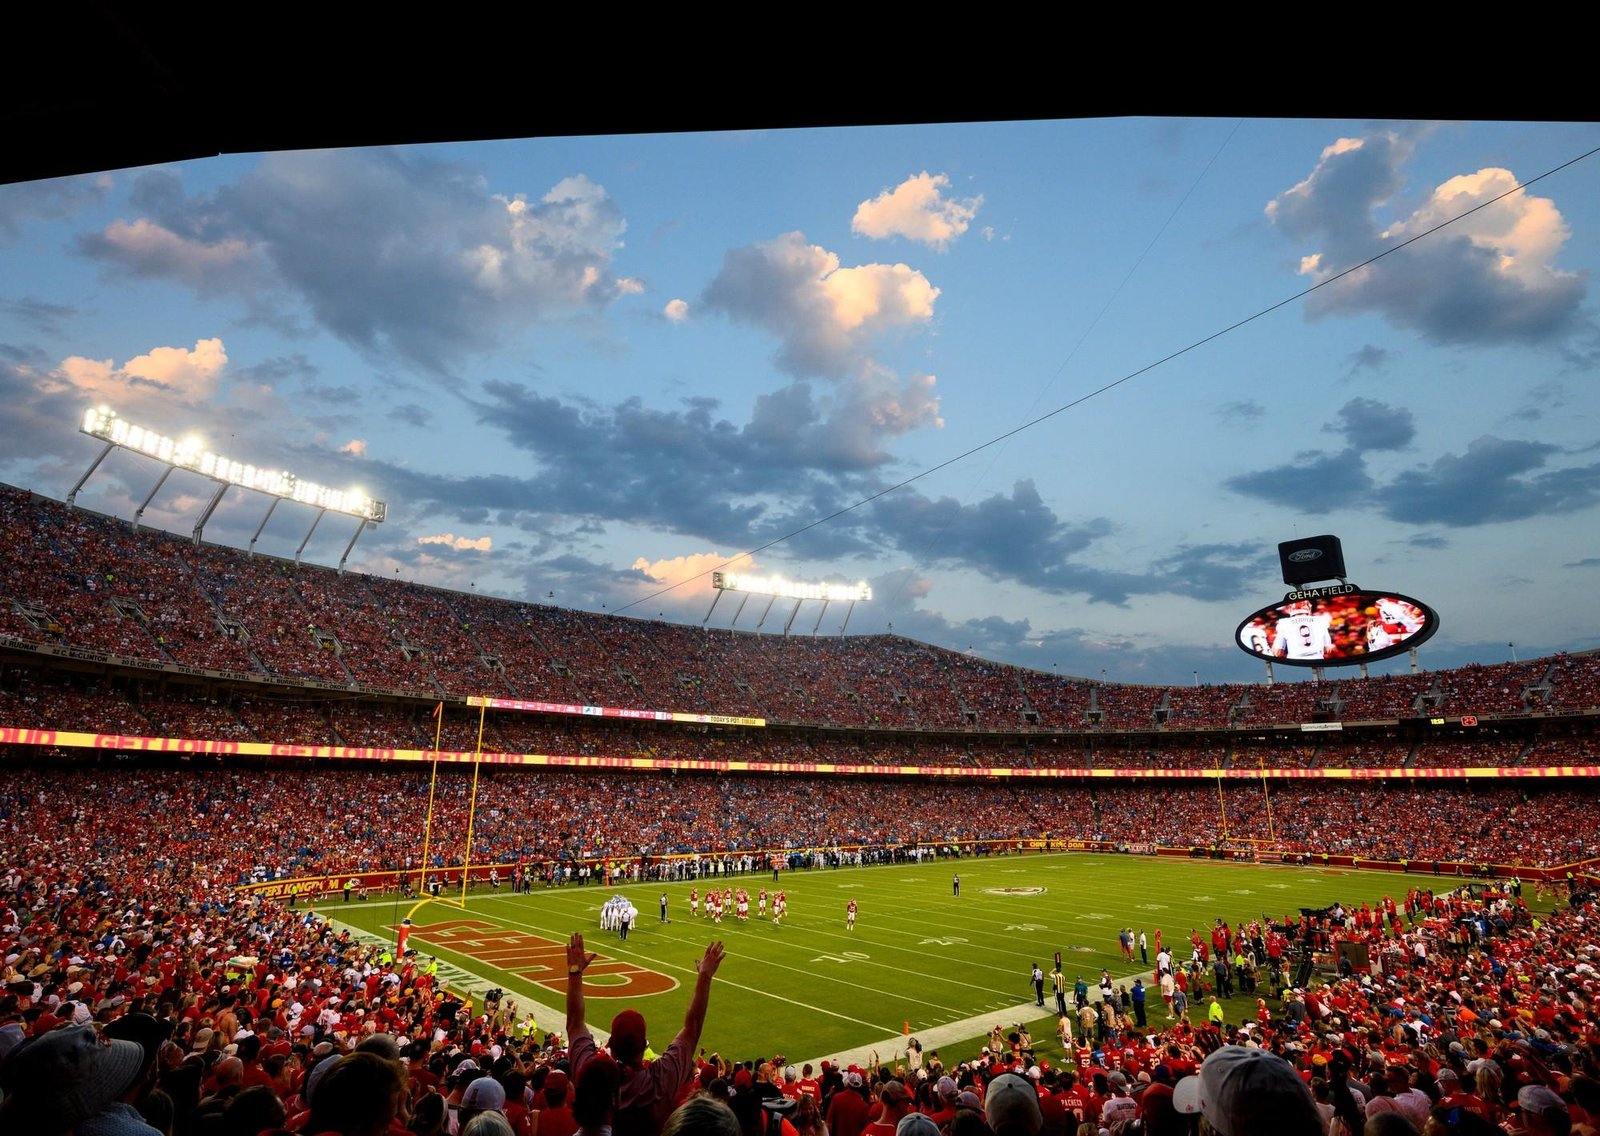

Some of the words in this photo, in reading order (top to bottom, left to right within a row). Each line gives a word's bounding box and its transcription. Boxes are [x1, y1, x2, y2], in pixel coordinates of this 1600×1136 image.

[1288, 589, 1320, 601] GEHA
[1321, 585, 1354, 596] FIELD
[137, 661, 165, 670] CHERRY
[192, 668, 206, 676] HILL
[1463, 717, 1475, 725] 25
[1350, 768, 1396, 778] GET
[1498, 767, 1551, 778] GET
[917, 936, 969, 946] 20
[809, 951, 870, 963] 10
